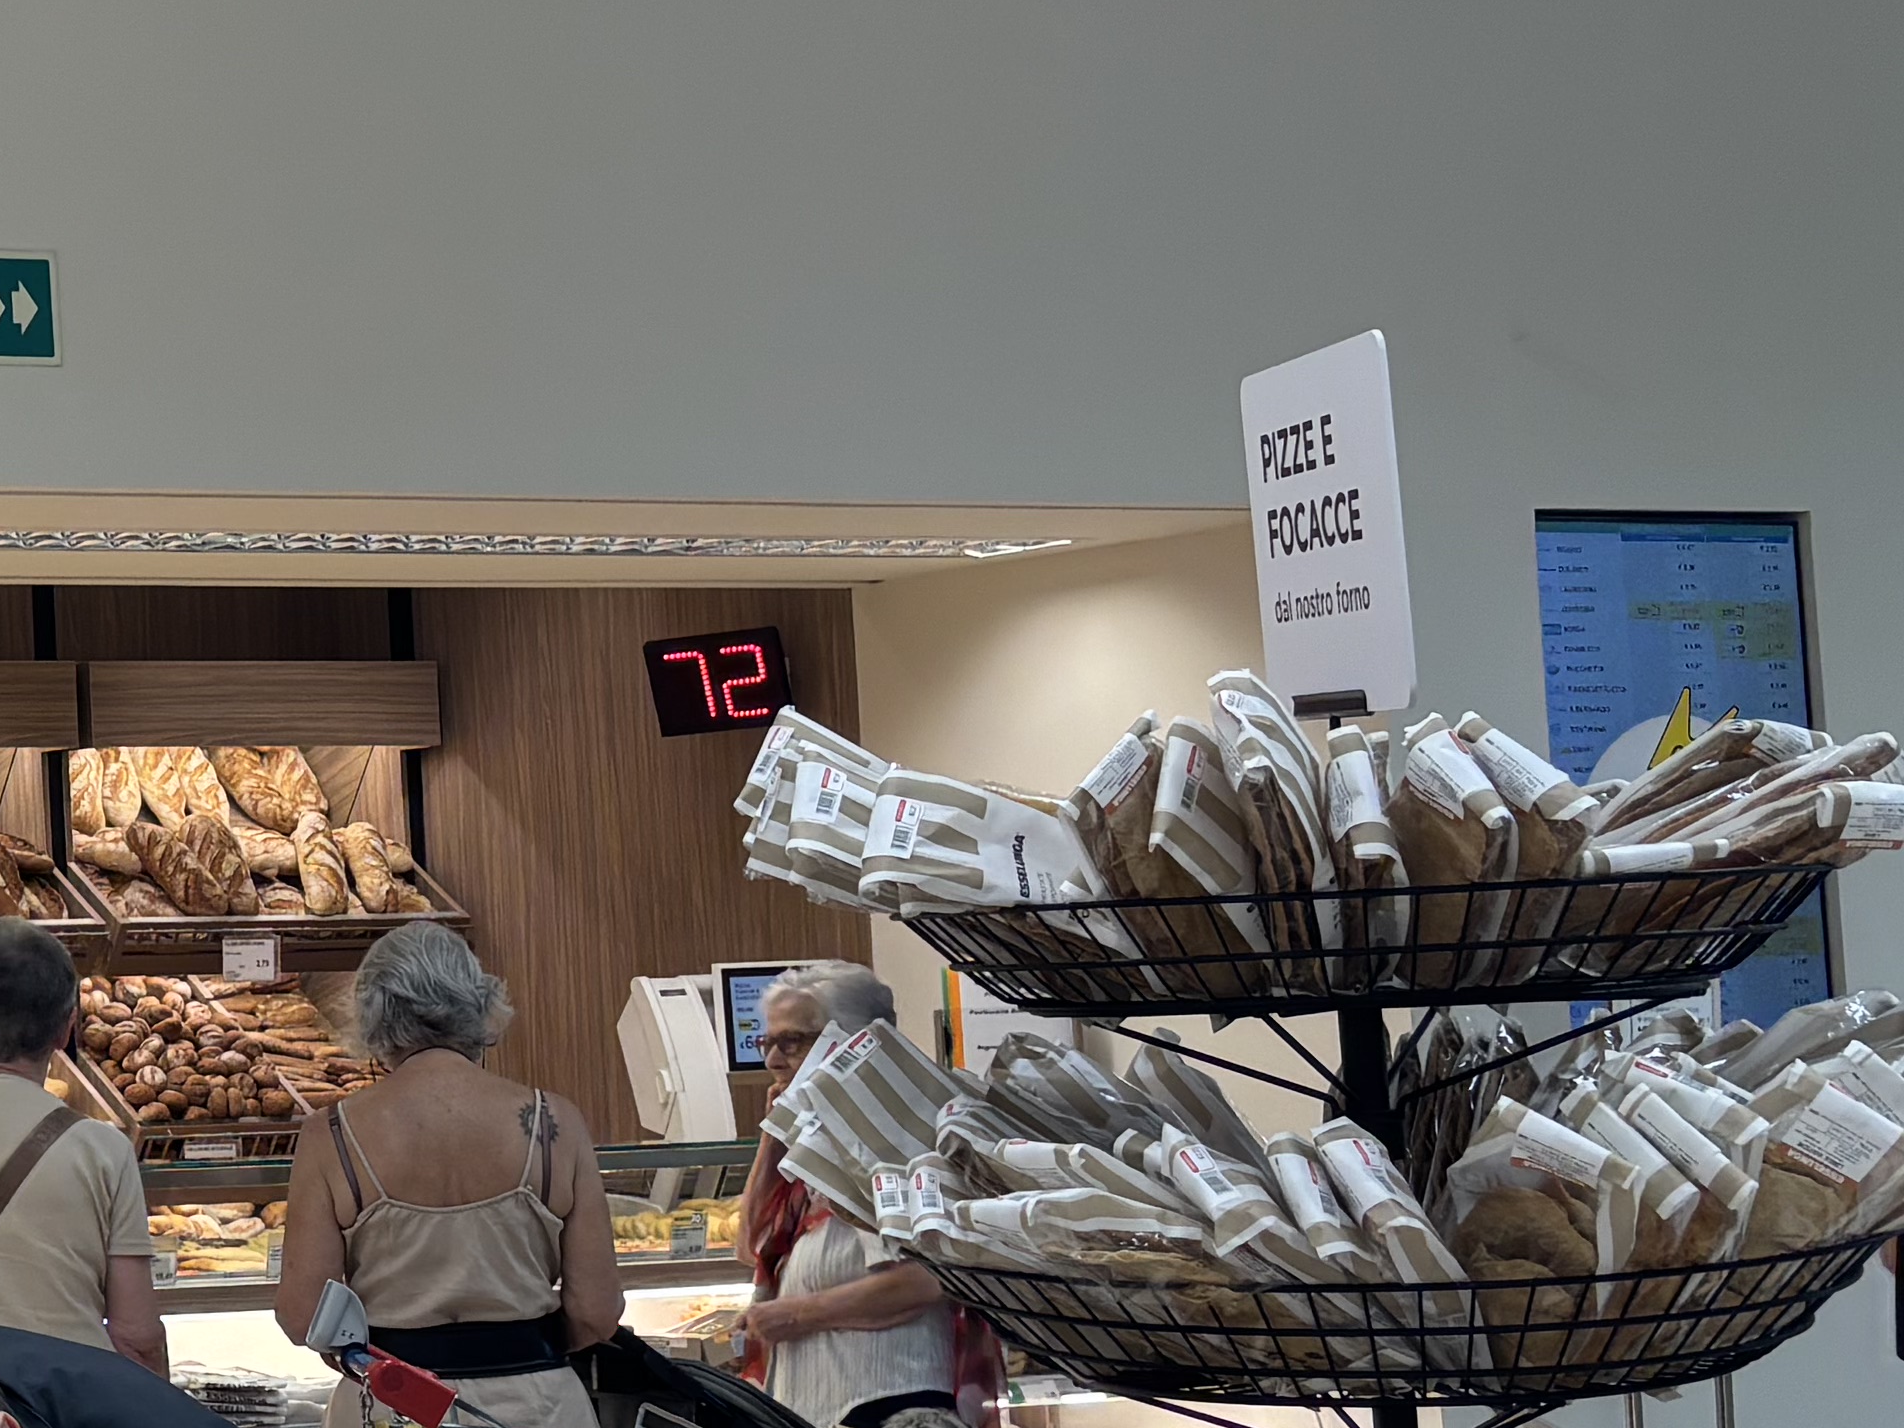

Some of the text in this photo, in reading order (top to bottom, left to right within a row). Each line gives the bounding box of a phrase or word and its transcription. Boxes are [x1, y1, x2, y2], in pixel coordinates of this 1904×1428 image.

[1260, 414, 1335, 483] PIZZE E
[1267, 488, 1363, 559] FOCACCE
[1275, 581, 1370, 623] dal nostro forno
[663, 643, 769, 718] 72
